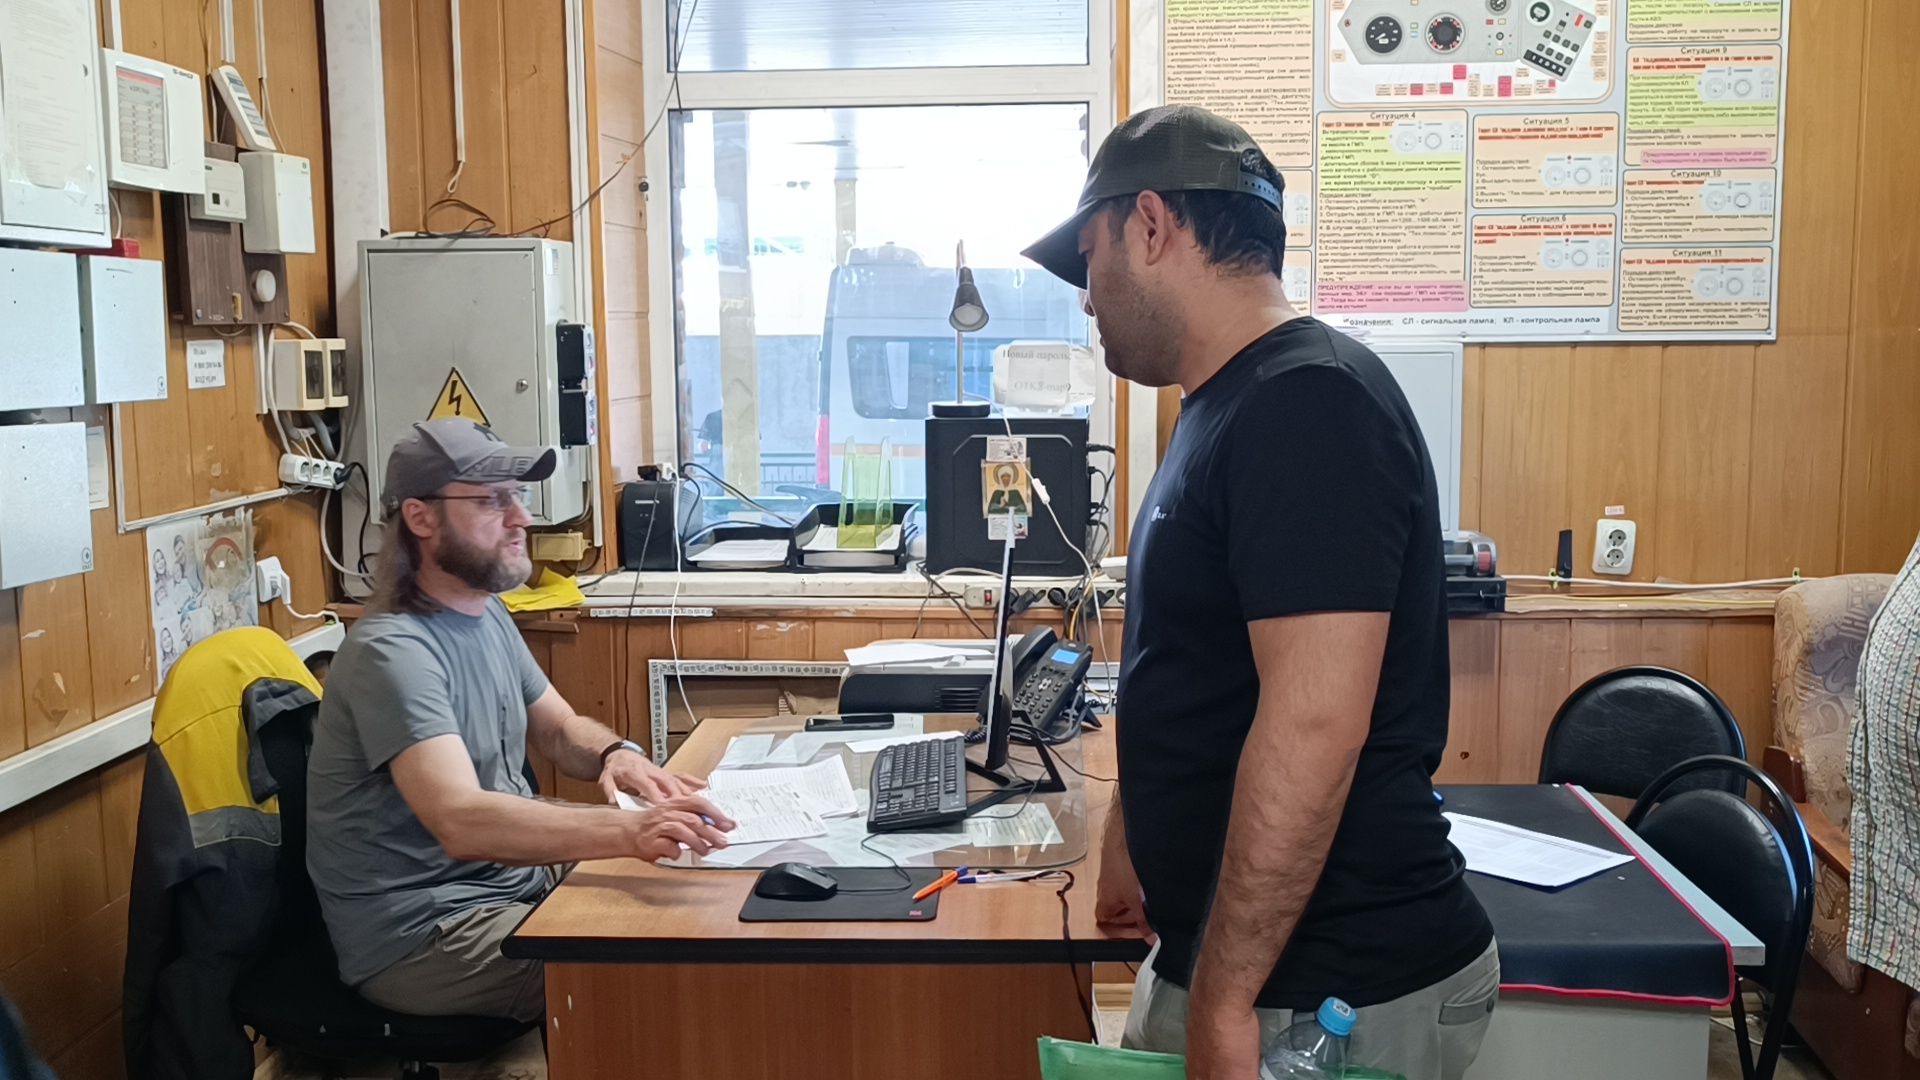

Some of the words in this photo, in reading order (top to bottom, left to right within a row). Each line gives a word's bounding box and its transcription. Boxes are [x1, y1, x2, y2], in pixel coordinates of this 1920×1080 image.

[1681, 47, 1720, 56] Ситуация
[1370, 112, 1409, 121] Ситуация
[1523, 117, 1563, 126] Ситуация
[1671, 170, 1710, 179] Ситуация
[1713, 169, 1722, 177] 10
[1521, 216, 1560, 225] Ситуация
[1672, 250, 1712, 259] Ситуация
[1714, 249, 1722, 257] 11
[1402, 317, 1414, 325] СЛ
[1002, 349, 1034, 359] Новый
